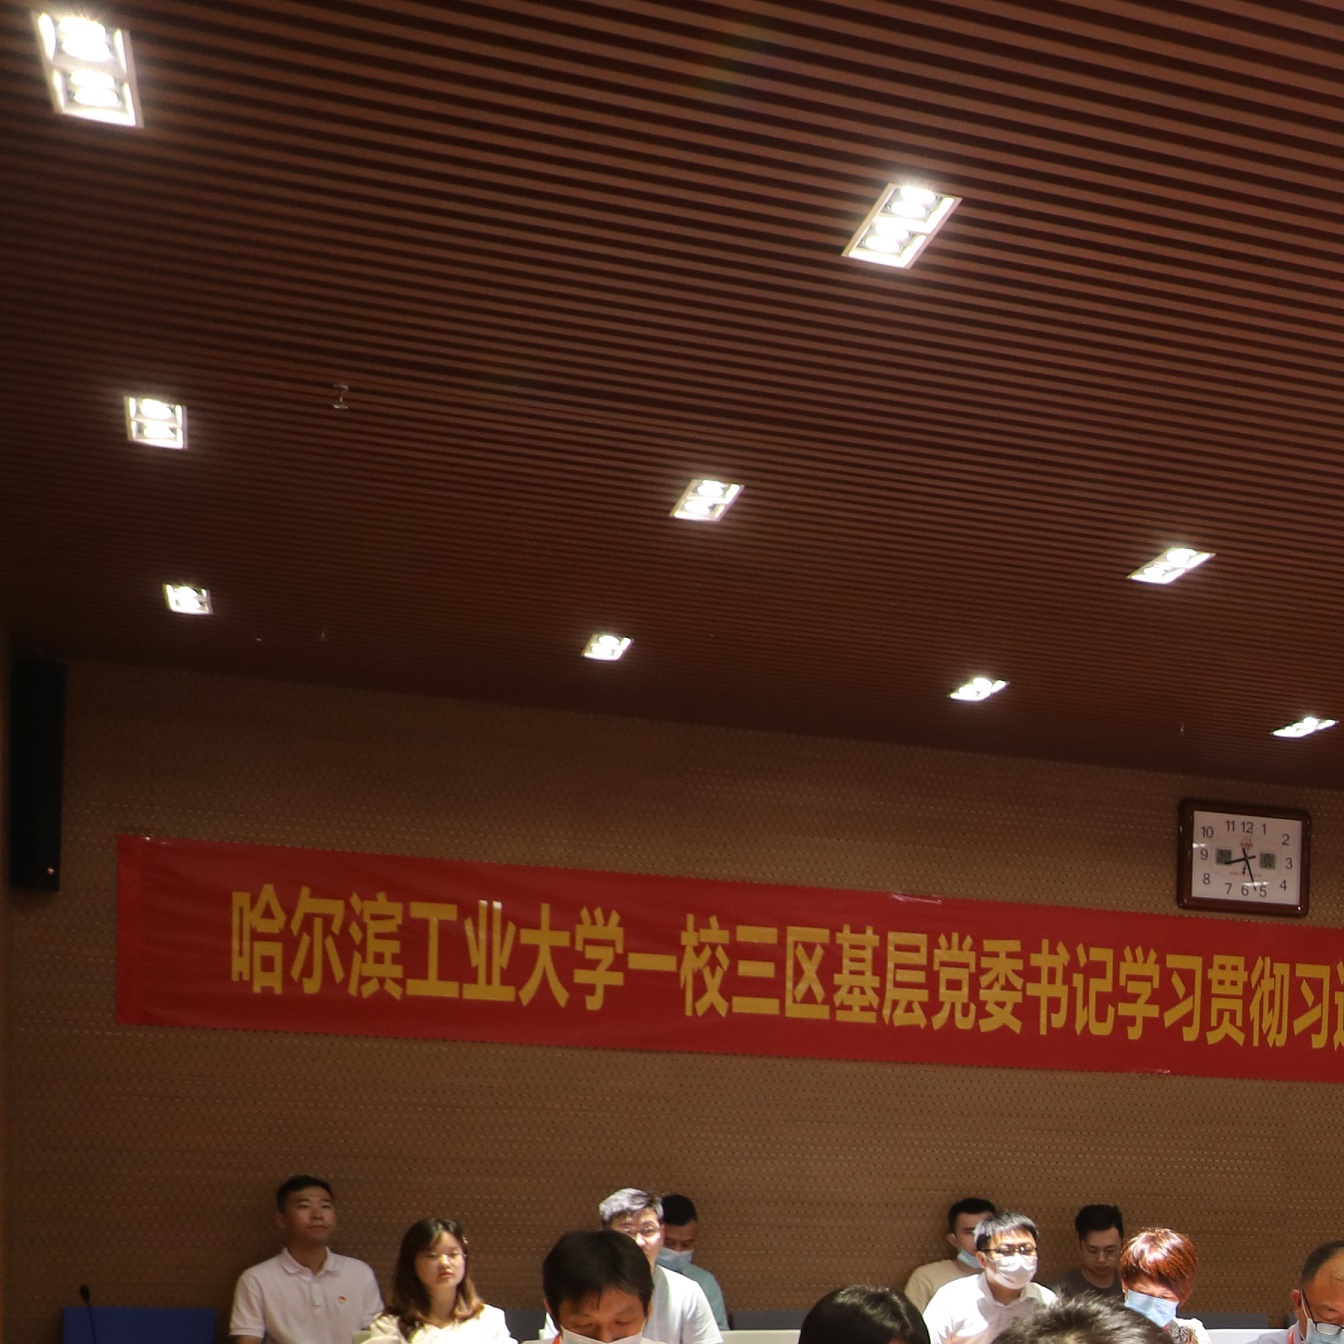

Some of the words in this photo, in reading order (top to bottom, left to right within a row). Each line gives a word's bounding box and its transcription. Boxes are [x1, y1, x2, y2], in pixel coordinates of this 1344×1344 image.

[1225, 819, 1236, 832] 11
[1240, 821, 1254, 834] 12
[1261, 823, 1267, 835] 1
[1201, 826, 1214, 838] 10
[1281, 834, 1290, 846] 2
[1200, 848, 1209, 860] 9
[1285, 858, 1293, 869] 3
[1202, 873, 1211, 885] 8
[1279, 879, 1287, 891] 4
[1224, 883, 1232, 894] 7
[1241, 885, 1249, 896] 6
[1259, 886, 1267, 897] 5
